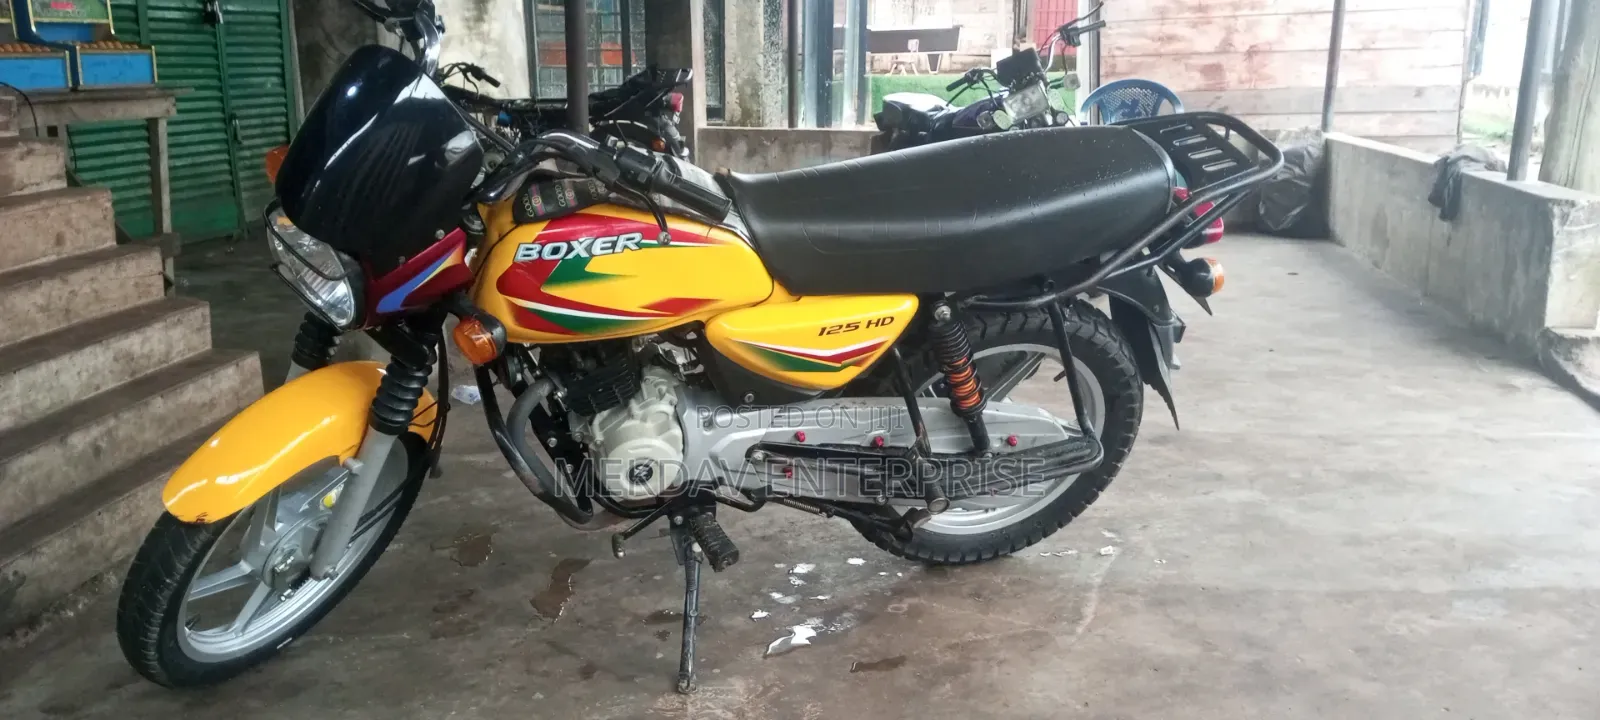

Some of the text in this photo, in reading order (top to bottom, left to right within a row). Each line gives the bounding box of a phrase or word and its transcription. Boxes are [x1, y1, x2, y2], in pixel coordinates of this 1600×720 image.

[513, 232, 643, 262] BOXER
[818, 316, 895, 336] 125 HD
